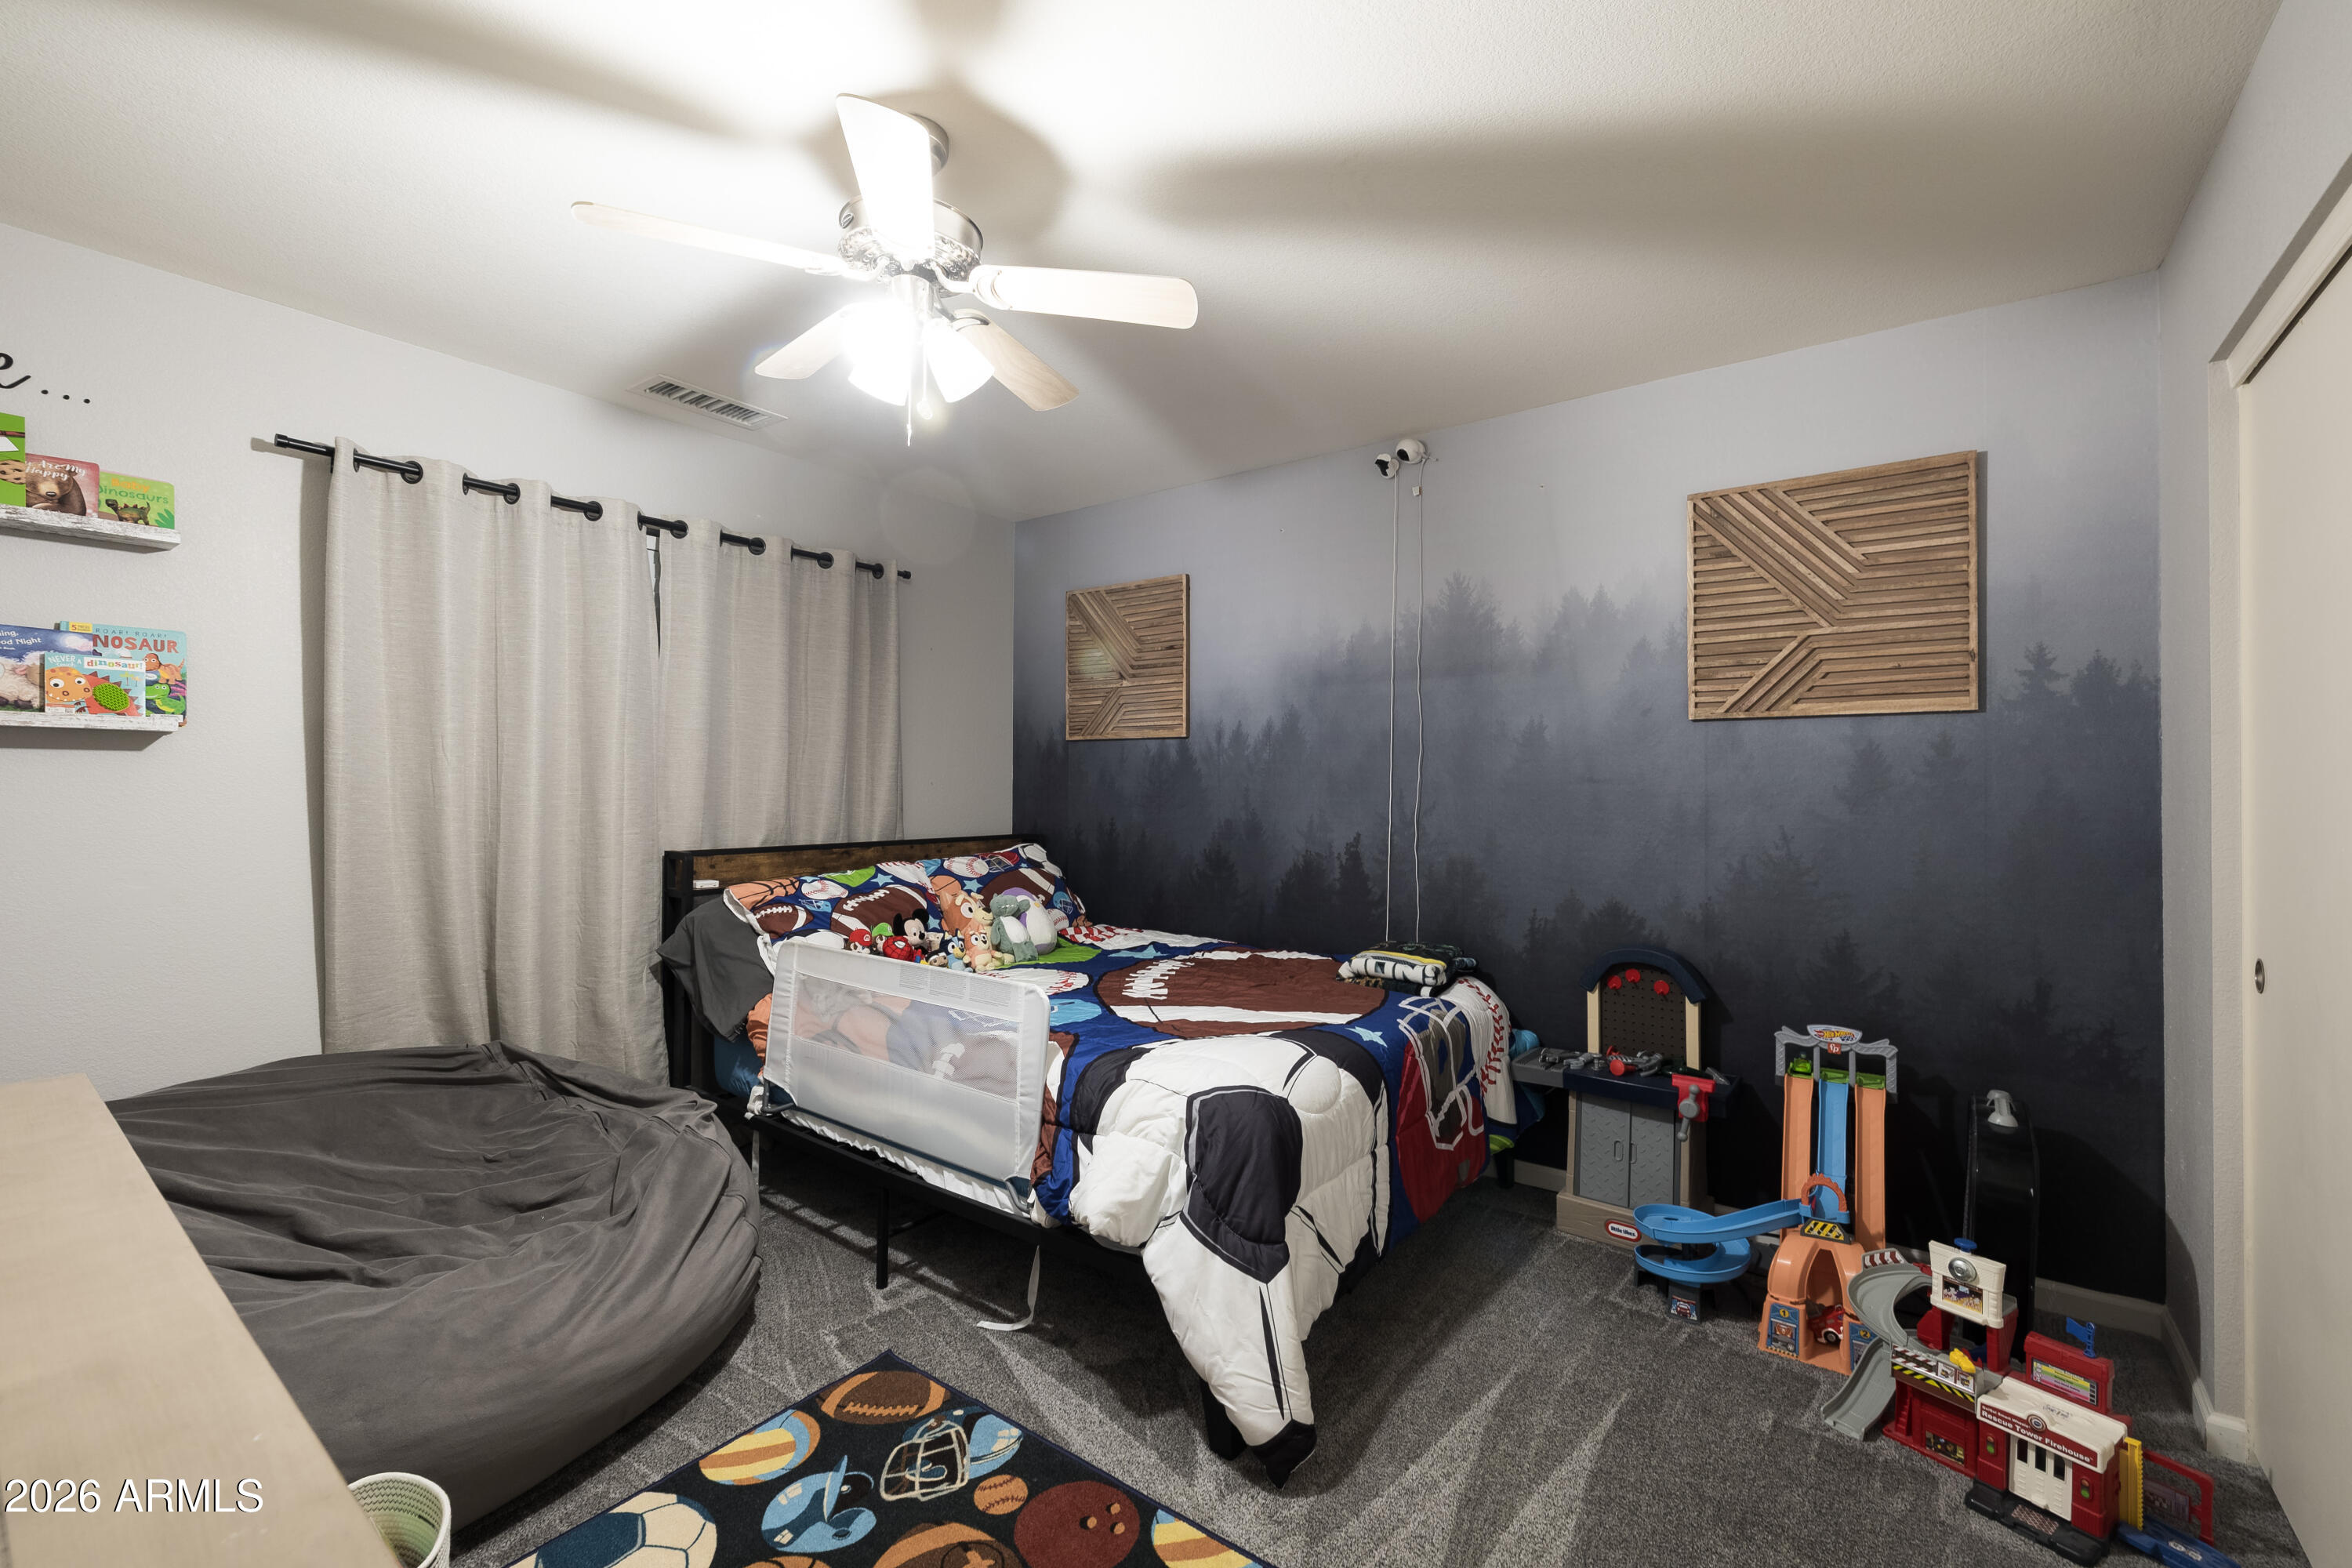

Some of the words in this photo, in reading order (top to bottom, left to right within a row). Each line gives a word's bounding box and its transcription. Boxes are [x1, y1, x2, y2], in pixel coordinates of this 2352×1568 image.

[25, 466, 68, 481] Happy
[65, 464, 85, 477] My
[111, 477, 151, 494] Baby
[16, 637, 42, 645] Night
[93, 633, 180, 654] NOSAUR
[47, 655, 76, 664] NEVER
[87, 659, 143, 670] dinosaur!
[1830, 1044, 1839, 1053] fp
[1981, 1410, 2013, 1430] Rescue
[2014, 1425, 2043, 1443] Tower
